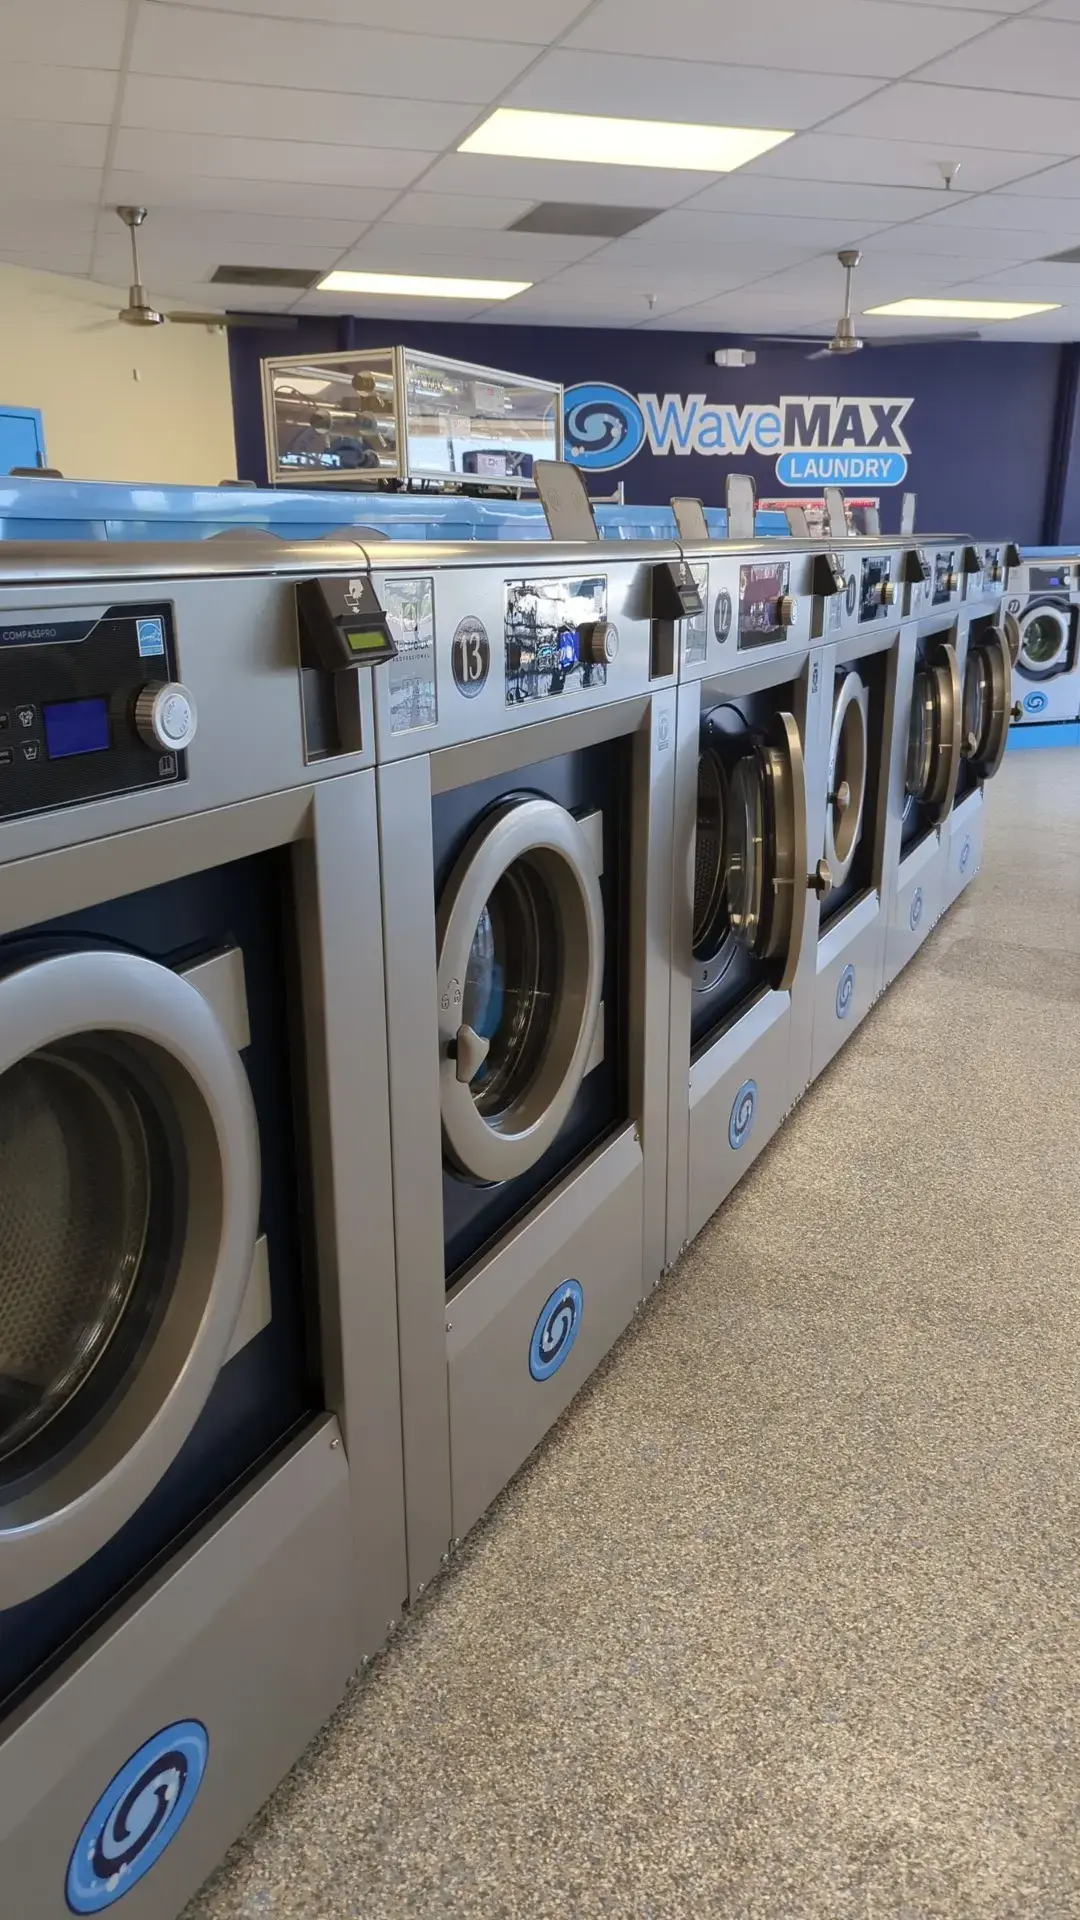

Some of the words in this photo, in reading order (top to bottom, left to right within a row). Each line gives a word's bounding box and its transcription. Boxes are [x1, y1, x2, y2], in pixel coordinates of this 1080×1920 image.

[644, 398, 906, 450] WaveMAX
[791, 458, 893, 479] LAUNDRY
[718, 598, 728, 633] 12
[2, 628, 57, 641] COMPASSPRO
[459, 633, 483, 683] 13
